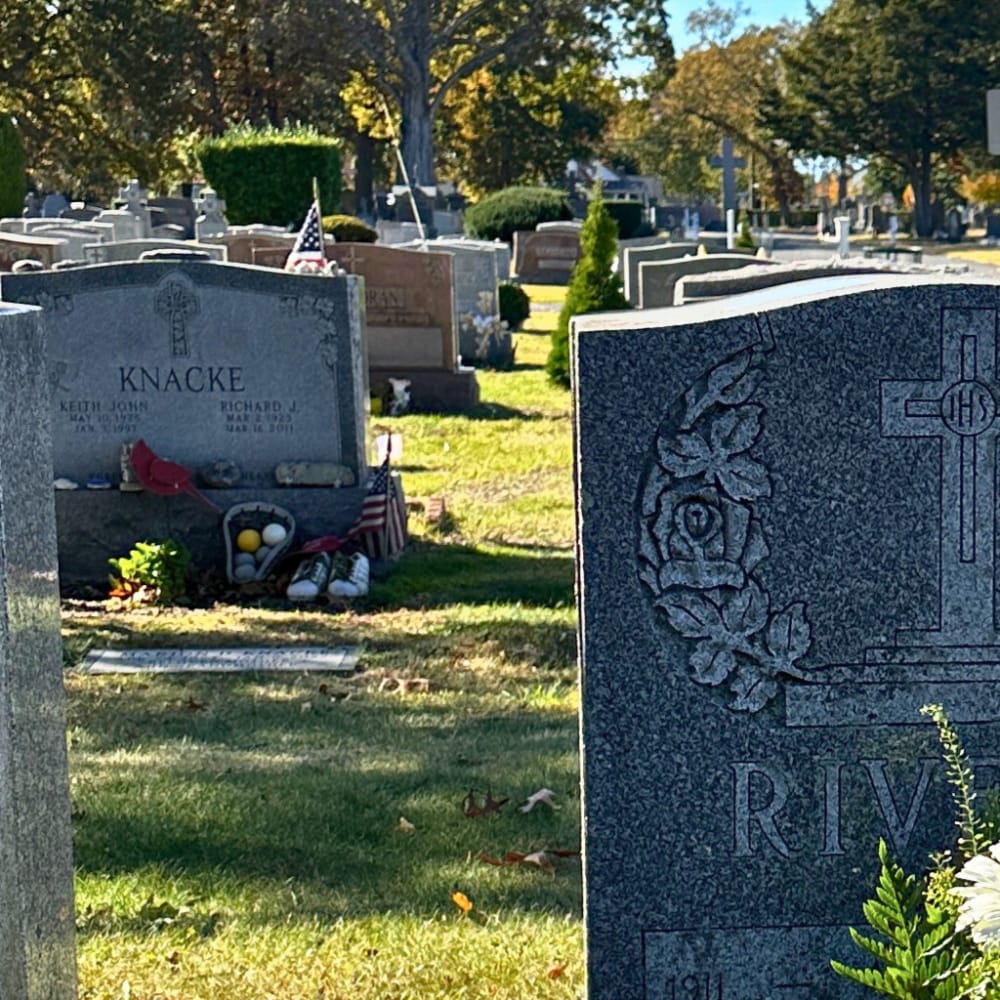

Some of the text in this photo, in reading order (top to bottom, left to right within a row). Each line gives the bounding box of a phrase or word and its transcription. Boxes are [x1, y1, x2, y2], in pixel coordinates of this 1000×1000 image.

[119, 366, 246, 393] KNACKE
[60, 401, 149, 412] KEITH JOHN
[220, 401, 281, 412] RICHARD
[950, 390, 987, 427] IHS
